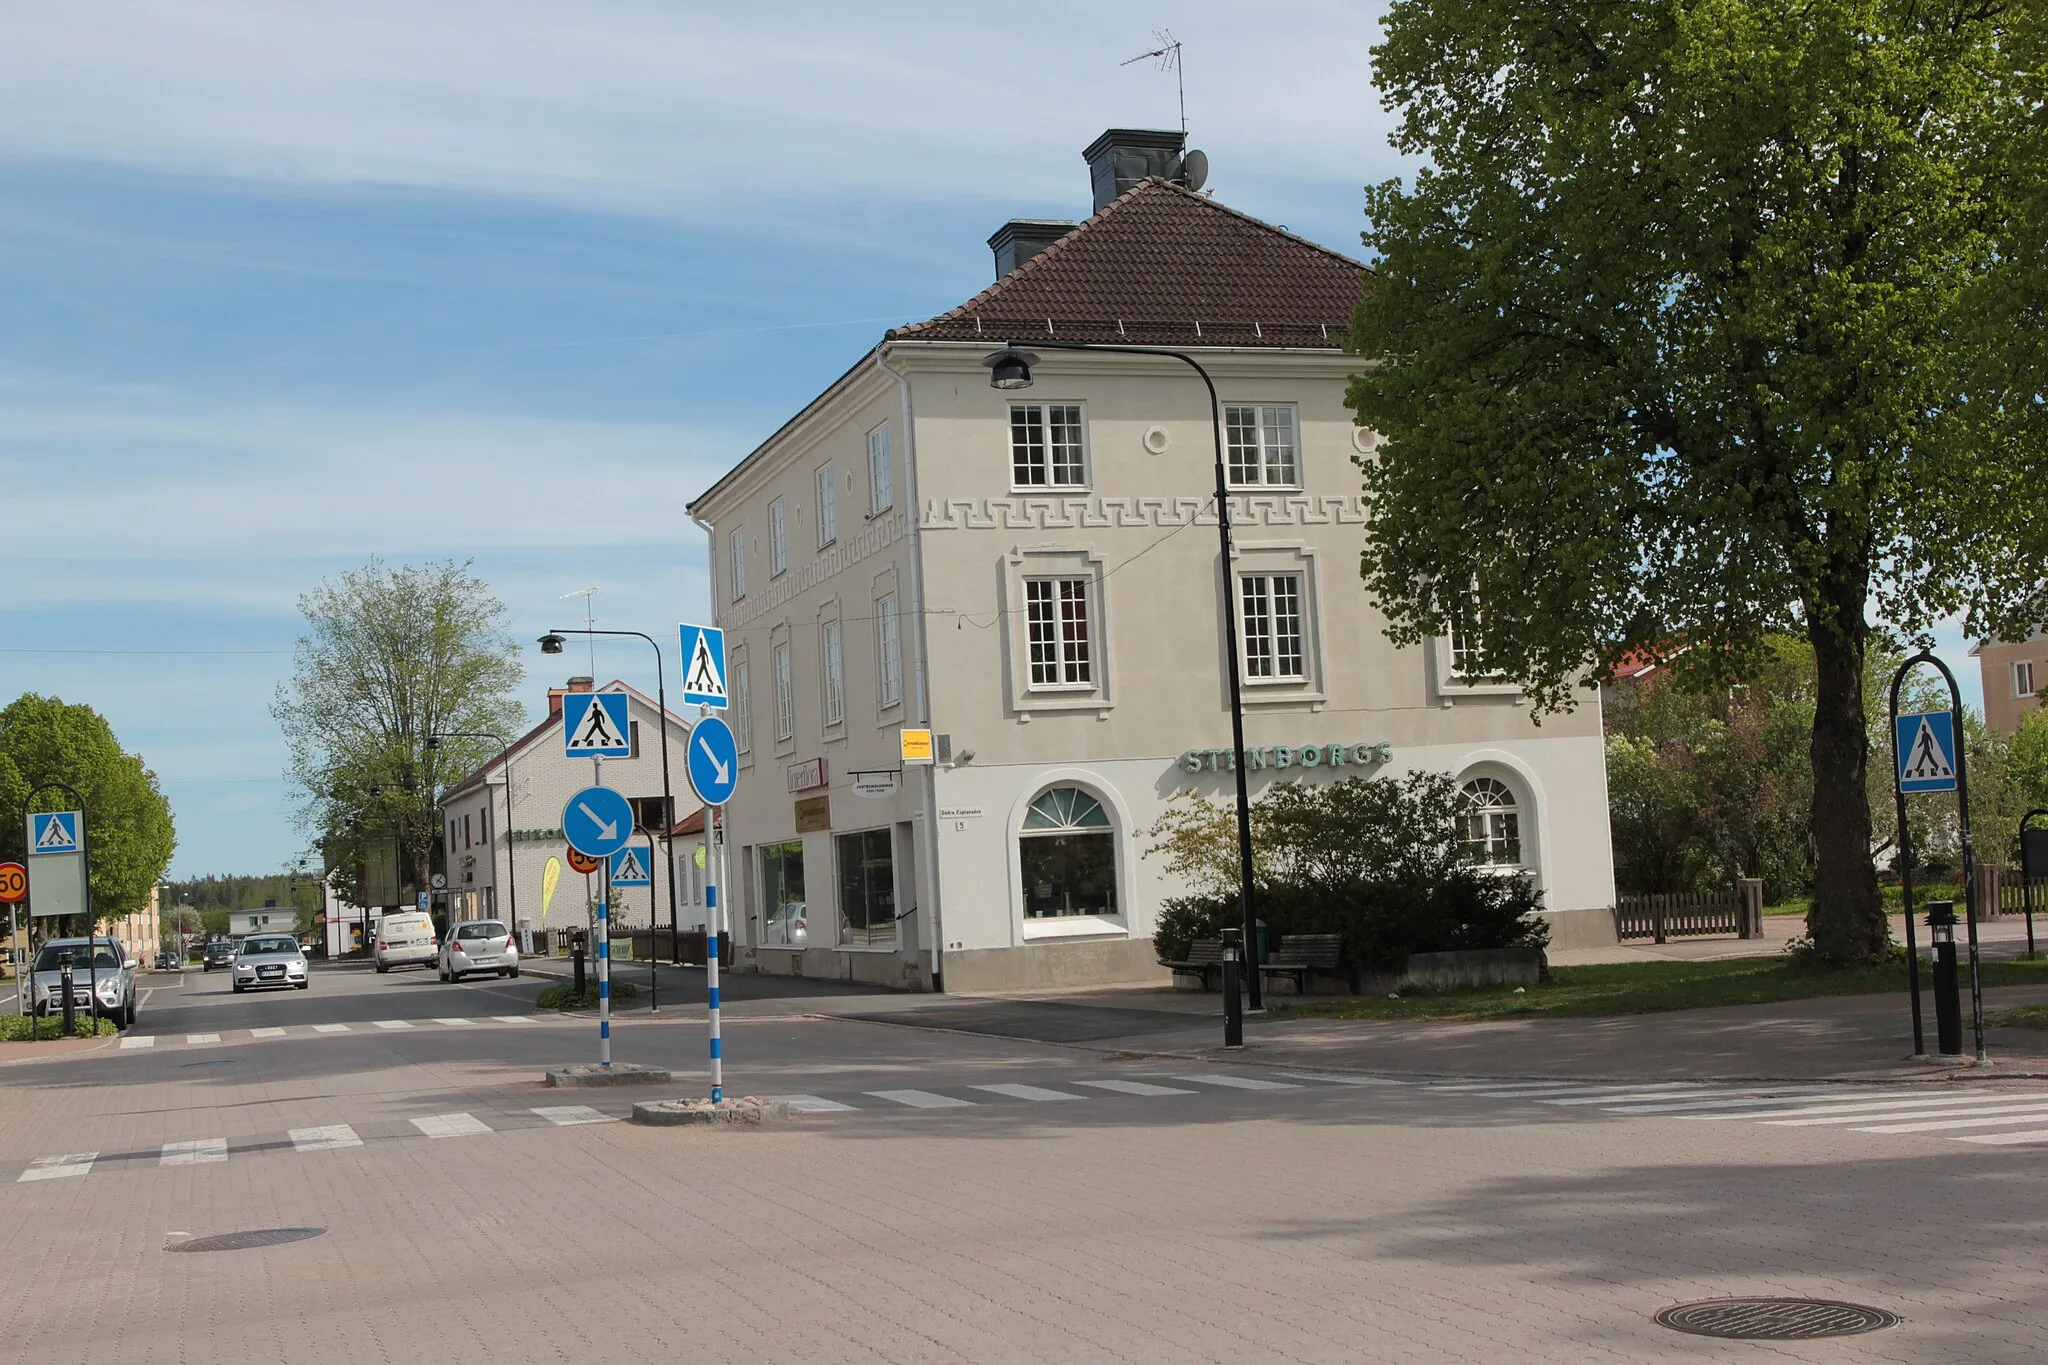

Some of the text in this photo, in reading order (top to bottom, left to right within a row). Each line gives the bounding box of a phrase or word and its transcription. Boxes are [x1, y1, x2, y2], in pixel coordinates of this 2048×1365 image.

[1181, 741, 1394, 773] STENBORGS
[959, 821, 965, 830] 5
[0, 872, 25, 893] 50
